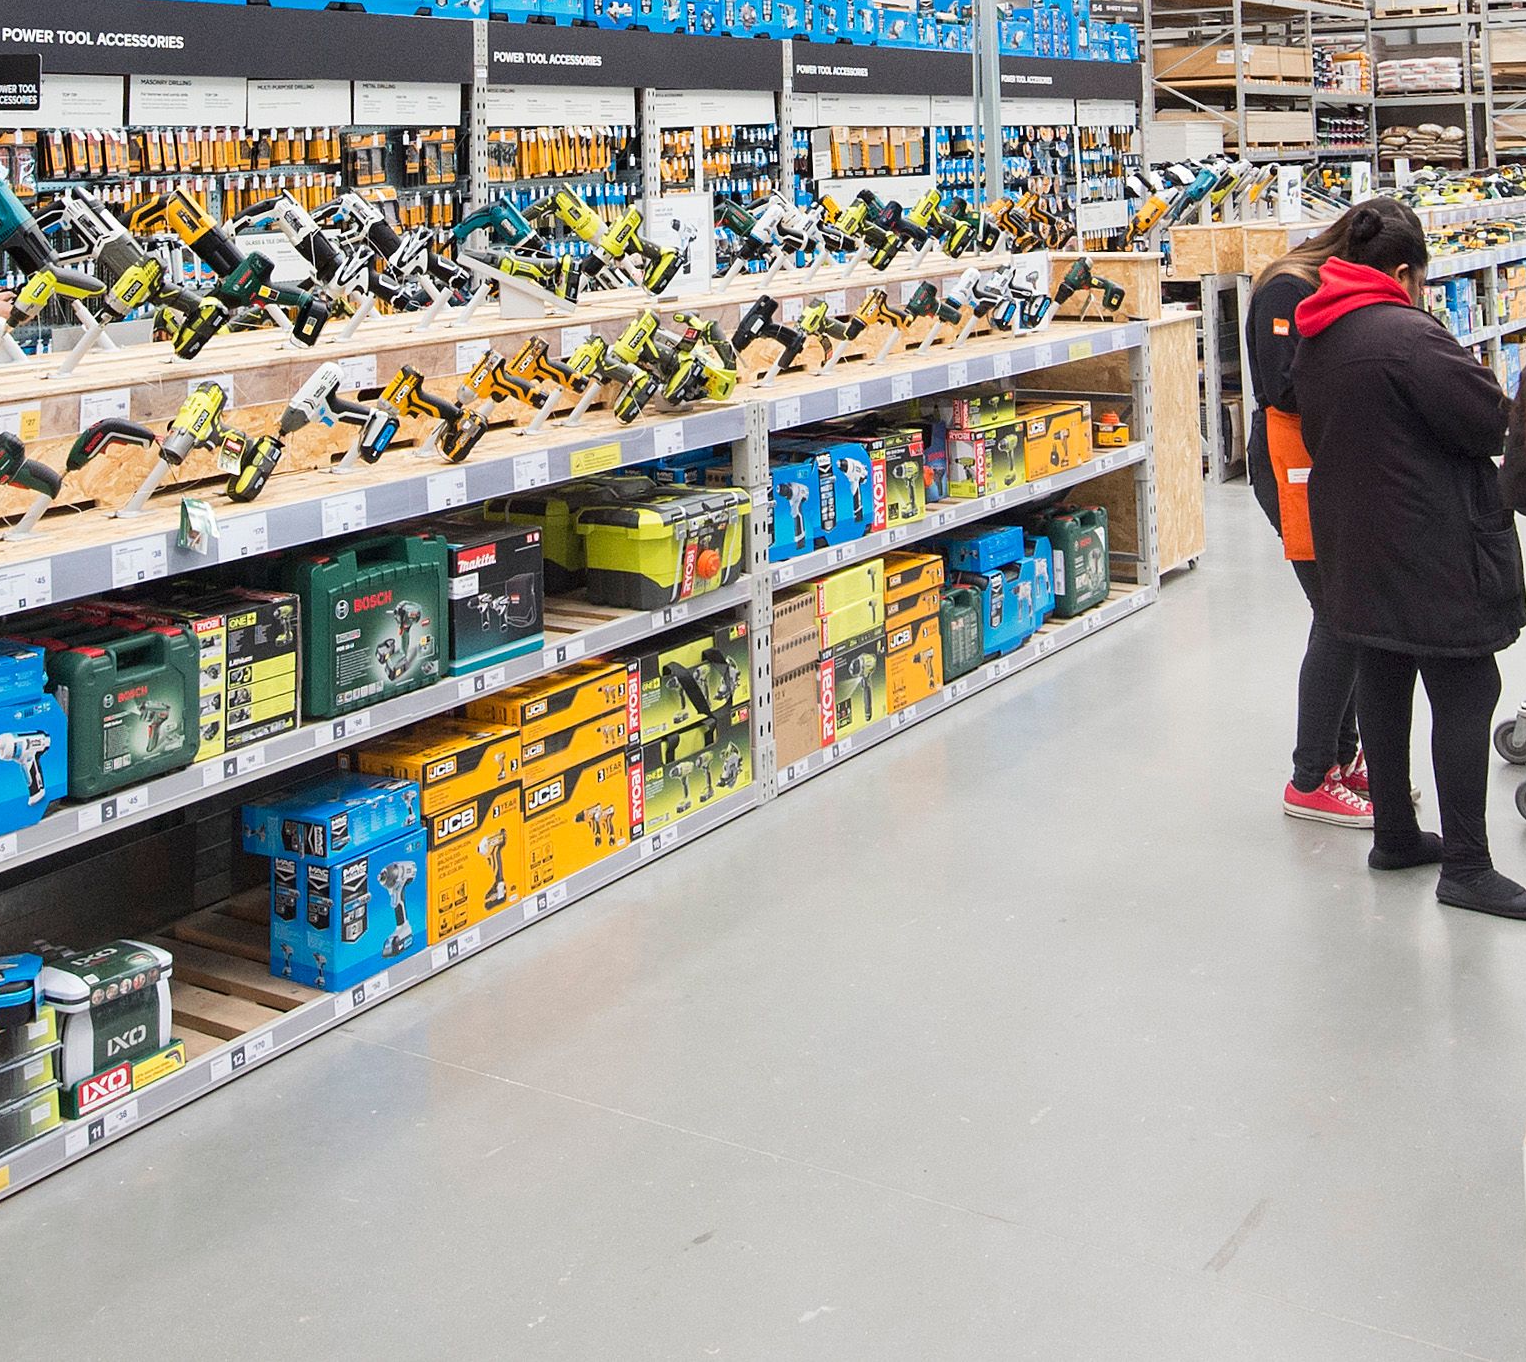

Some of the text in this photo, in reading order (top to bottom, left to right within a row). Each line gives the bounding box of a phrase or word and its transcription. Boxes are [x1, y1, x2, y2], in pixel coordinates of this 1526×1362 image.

[2, 27, 184, 49] POWER TOOL ACCESSORIES
[493, 51, 602, 67] POWER TOOL ACCESSORIES
[796, 64, 868, 78] POWER TOOL ACCESSORIES
[17, 82, 38, 94] TOOL
[123, 279, 143, 301] RYOBI
[519, 355, 533, 374] JCB
[473, 369, 488, 388] JCB
[395, 384, 410, 404] JCB
[191, 411, 210, 433] RYOBI
[1028, 421, 1046, 436] JCB
[872, 441, 883, 450] 18V
[976, 443, 984, 484] RYOBI
[873, 464, 885, 525] RYOBI
[457, 552, 497, 574] makita
[684, 549, 696, 595] RYOBI
[35, 576, 46, 585] £45
[353, 591, 393, 613] BOSCH
[196, 617, 219, 632] RYOBI
[229, 612, 256, 630] ONE+
[665, 611, 671, 621] 8
[890, 629, 911, 648] JCB
[229, 656, 253, 666] Lithium
[557, 647, 566, 660] 7
[822, 648, 834, 660] 18V
[476, 677, 483, 689] 6
[117, 686, 148, 703] BOSCH
[629, 678, 638, 729] RYOBI
[821, 665, 834, 740] RYOBI
[526, 702, 547, 716] JCB
[336, 726, 343, 737] 5
[524, 743, 544, 757] JCB
[226, 762, 234, 774] 4
[429, 761, 456, 779] JCB
[598, 763, 623, 782] 3 YEAR
[527, 782, 563, 808] JCB
[632, 769, 642, 820] RYOBI
[105, 805, 114, 817] 3
[494, 797, 518, 818] 3 YEAR
[436, 811, 476, 836] JCB
[538, 897, 546, 908] 15
[71, 948, 118, 967] IXO
[448, 944, 458, 956] 14
[354, 989, 364, 1003] 13
[107, 1024, 147, 1058] IXO
[232, 1051, 244, 1066] 12
[81, 1066, 128, 1106] IXO
[91, 1124, 102, 1139] 11
